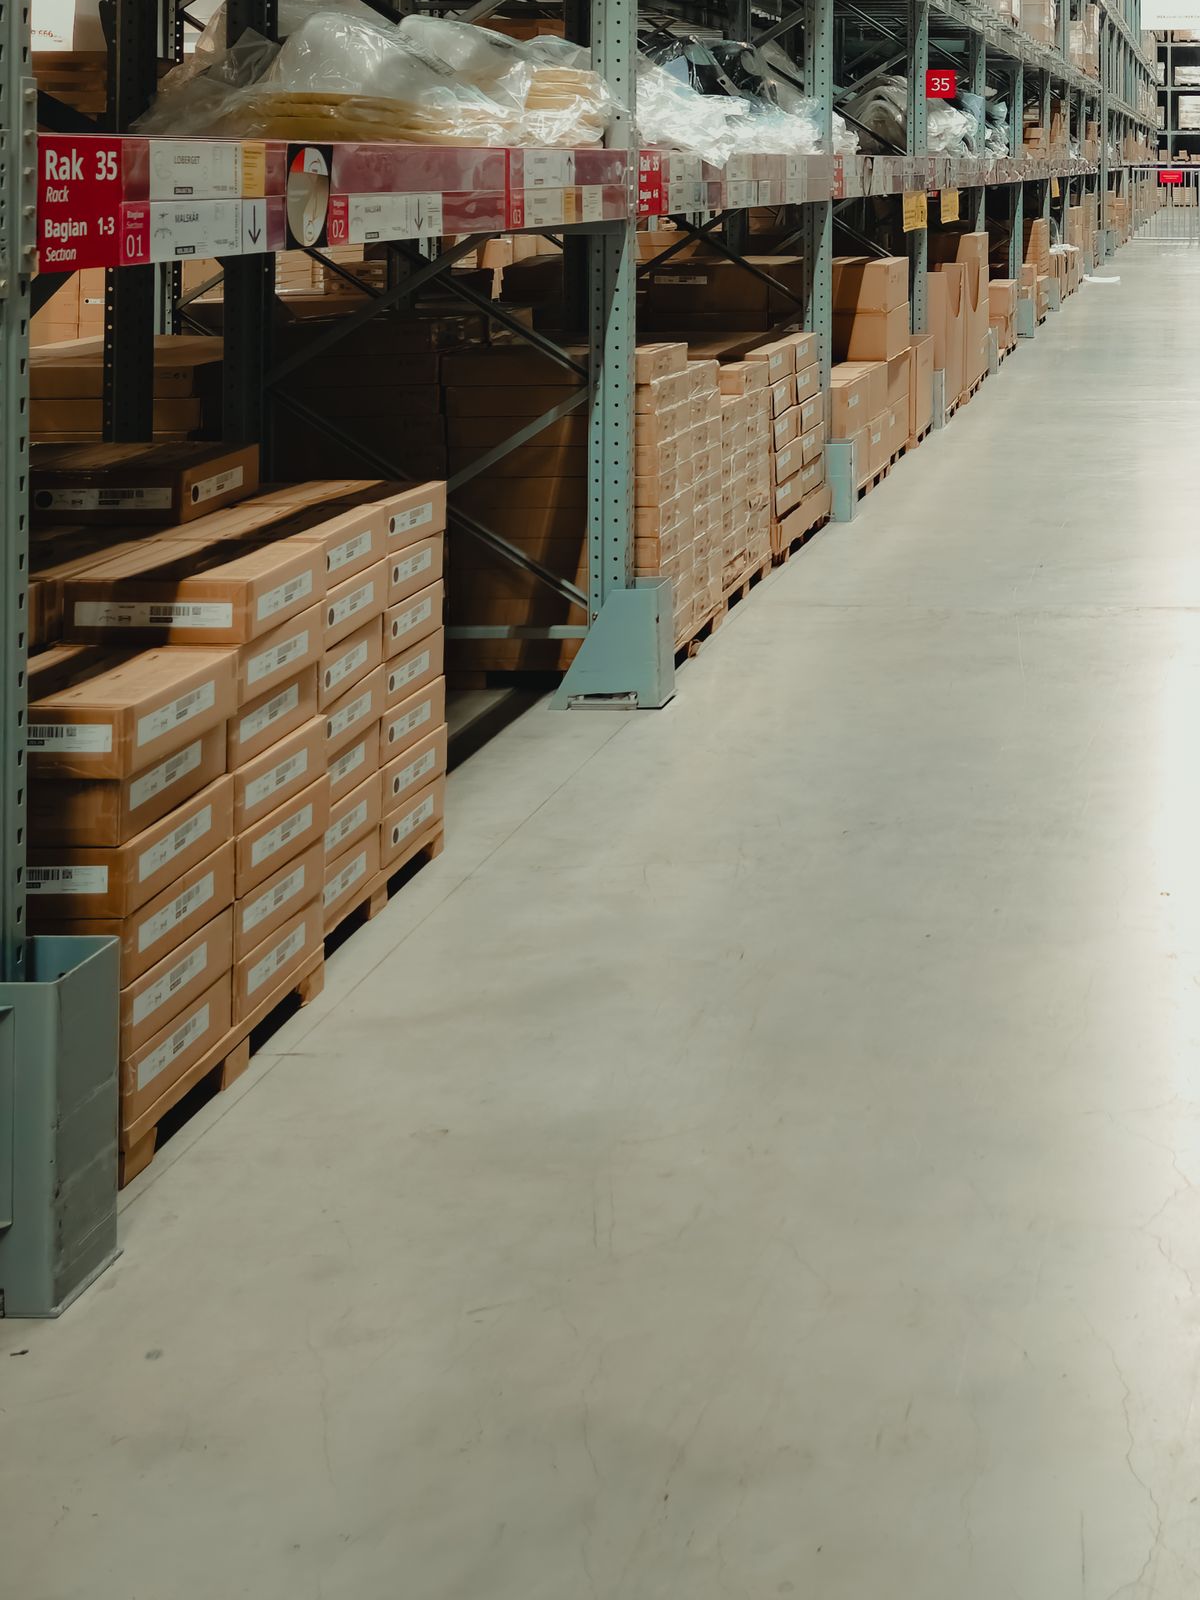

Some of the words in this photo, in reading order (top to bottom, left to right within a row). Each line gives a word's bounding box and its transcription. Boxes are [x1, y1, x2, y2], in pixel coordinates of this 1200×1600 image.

[930, 77, 951, 92] 35
[45, 148, 84, 181] Rak
[95, 150, 118, 181] 35
[46, 186, 69, 203] Rack
[44, 217, 88, 243] Bagian
[97, 217, 115, 236] 1-3
[332, 219, 345, 239] 02
[46, 246, 77, 263] Section
[126, 234, 144, 258] 01
